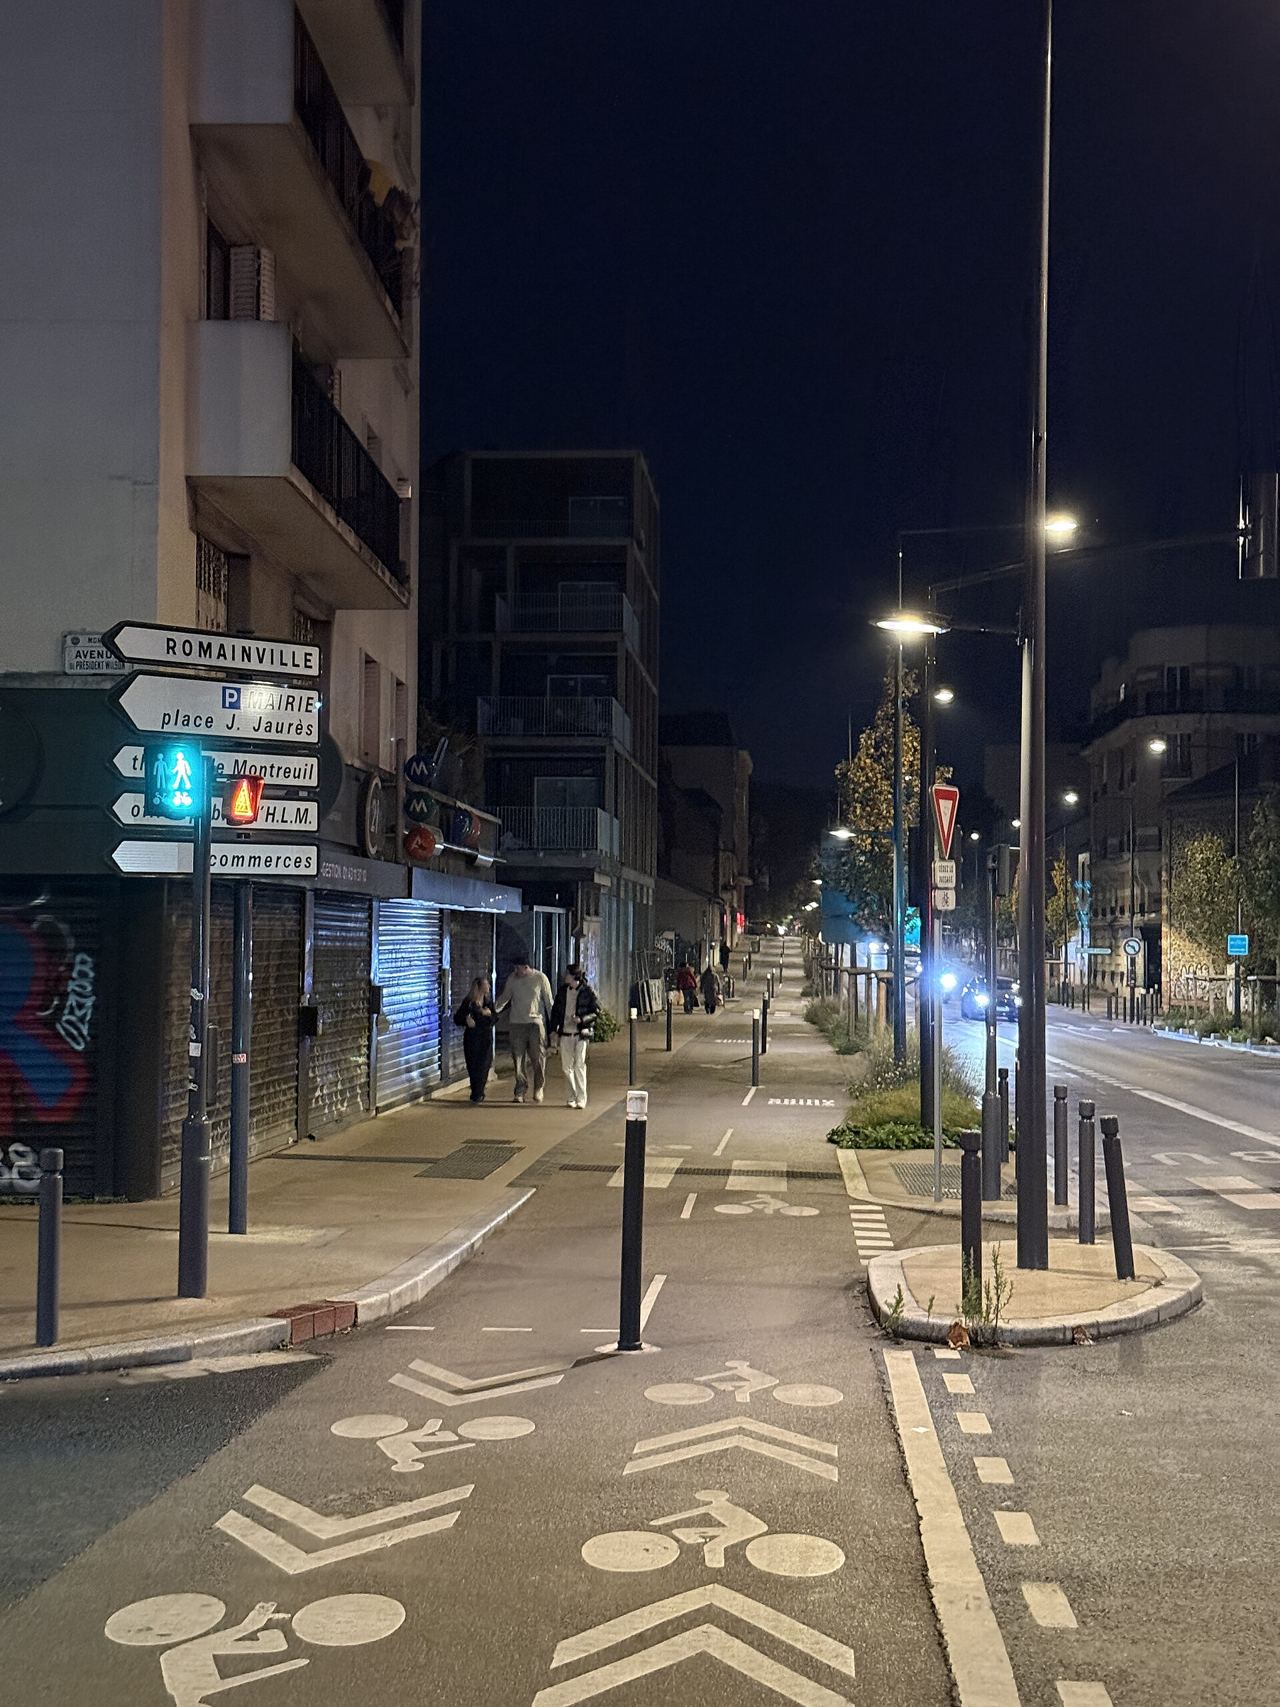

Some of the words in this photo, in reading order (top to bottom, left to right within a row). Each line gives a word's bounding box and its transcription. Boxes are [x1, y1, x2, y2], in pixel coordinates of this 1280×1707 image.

[75, 650, 115, 660] AVENU
[166, 637, 313, 669] ROMAINVILLE
[225, 688, 238, 708] P
[247, 690, 315, 713] MAIRIE
[161, 709, 214, 730] place
[225, 713, 240, 731] J.
[252, 715, 314, 736] Jaurès
[232, 758, 315, 780] Montreuil
[209, 853, 312, 869] commerces
